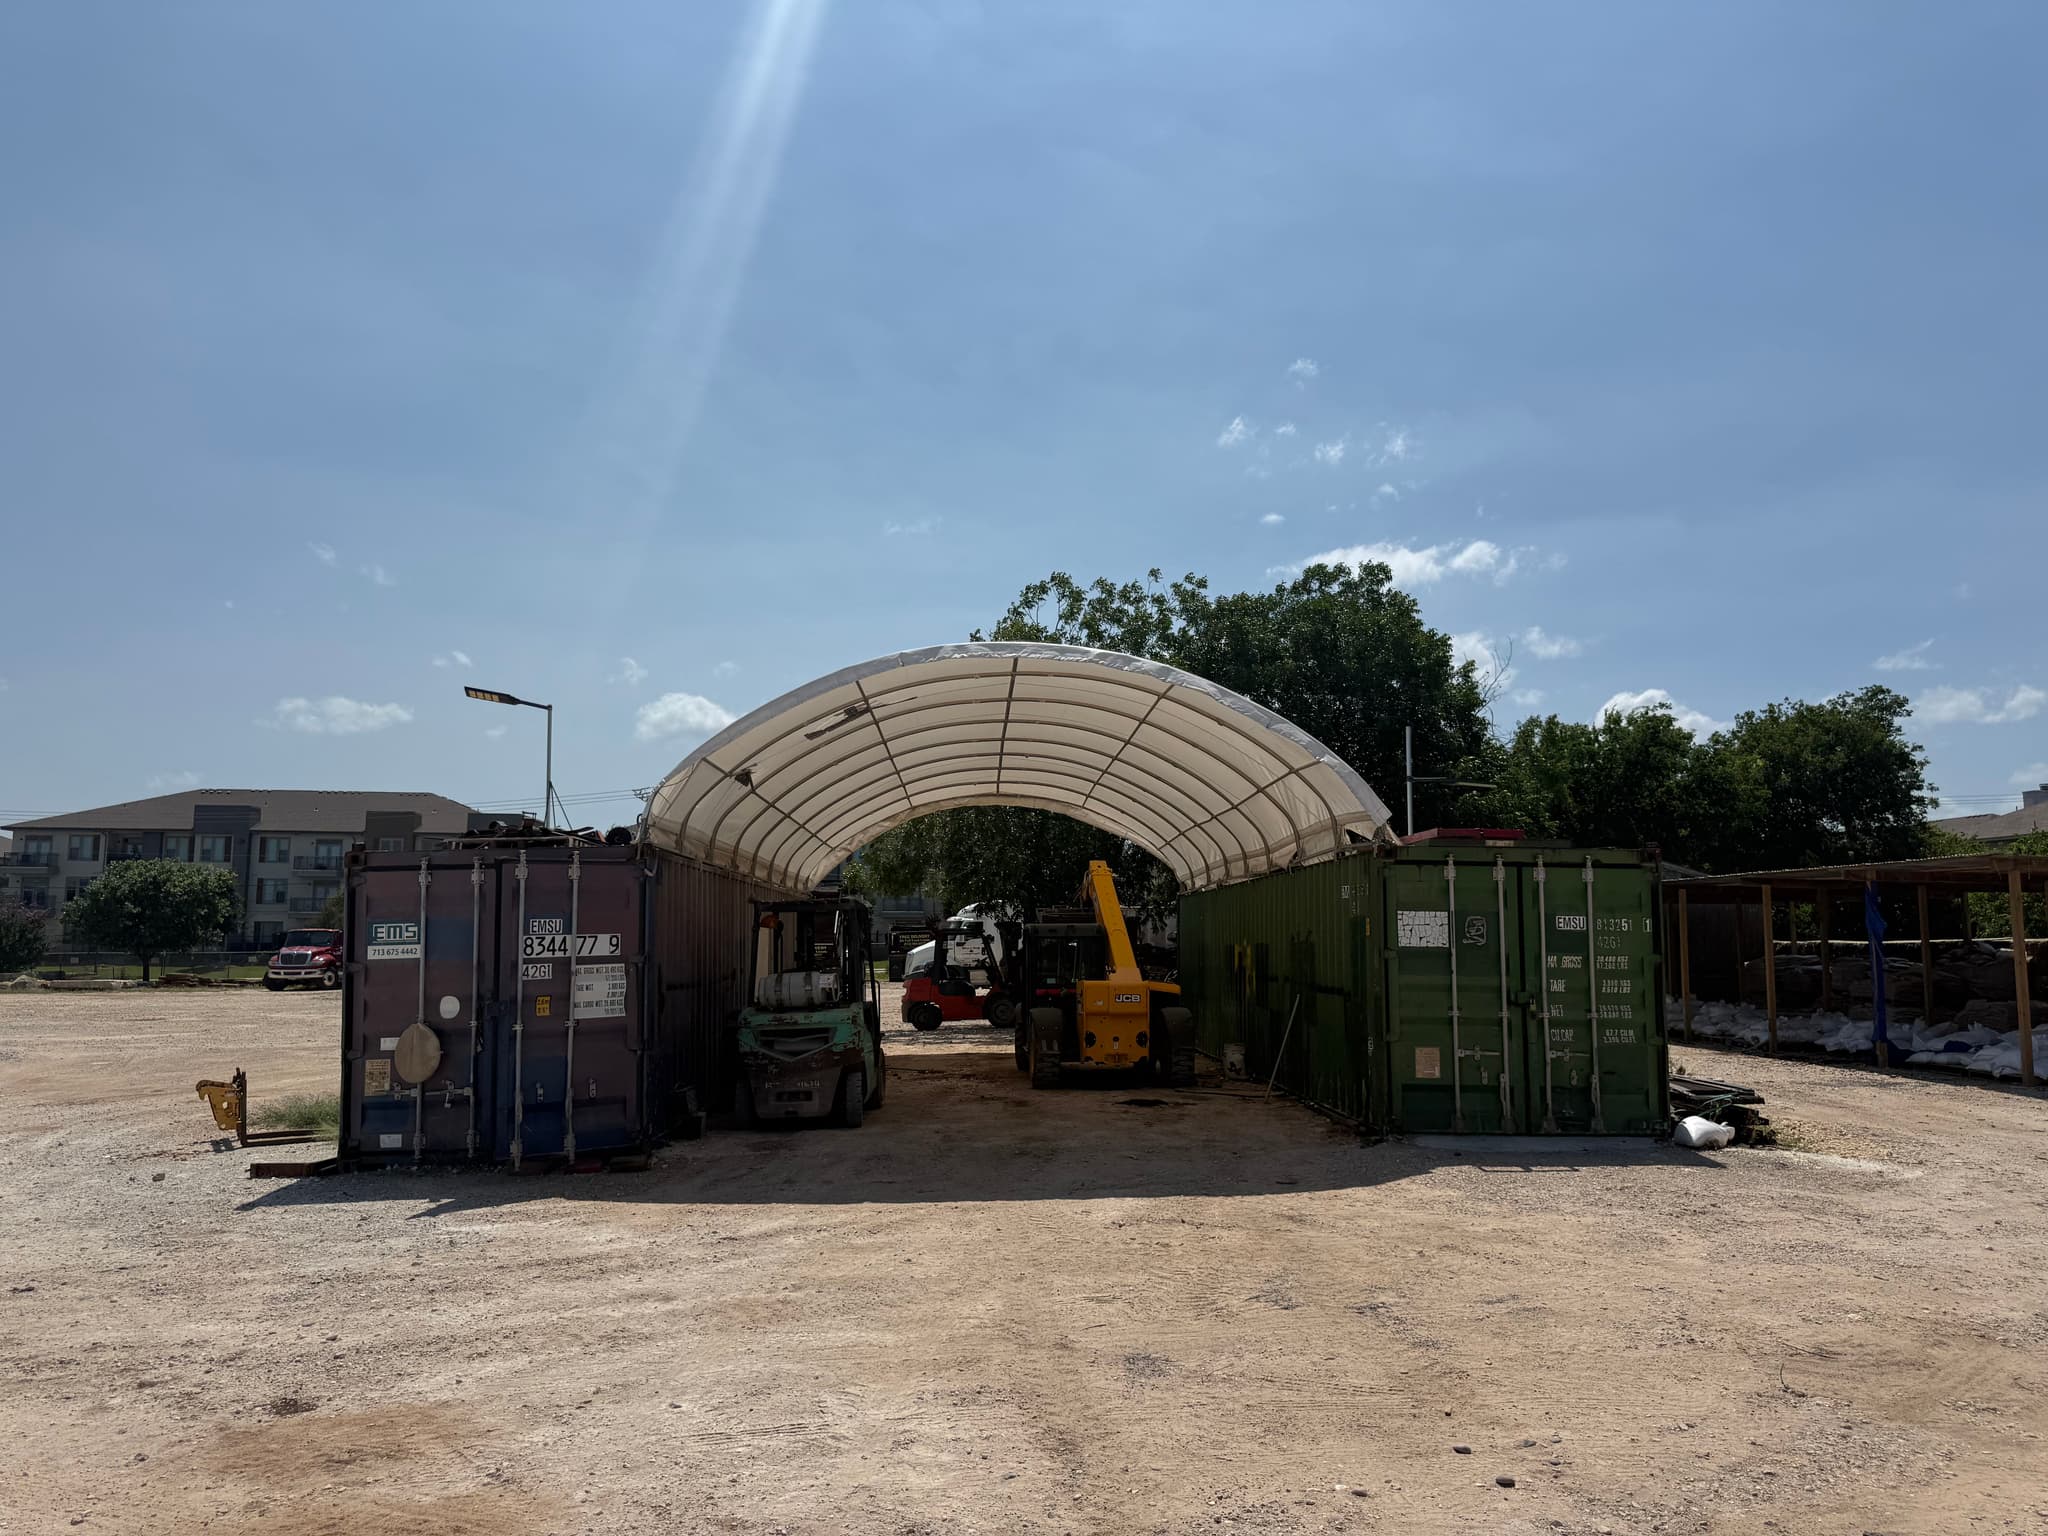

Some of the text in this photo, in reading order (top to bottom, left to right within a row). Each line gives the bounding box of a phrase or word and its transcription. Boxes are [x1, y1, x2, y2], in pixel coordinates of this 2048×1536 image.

[531, 920, 562, 933] EMSU
[1556, 916, 1586, 930] EMSU
[373, 923, 418, 941] EMS
[609, 935, 620, 954] 9
[1550, 979, 1566, 992] TARE
[1115, 994, 1141, 1003] JCB
